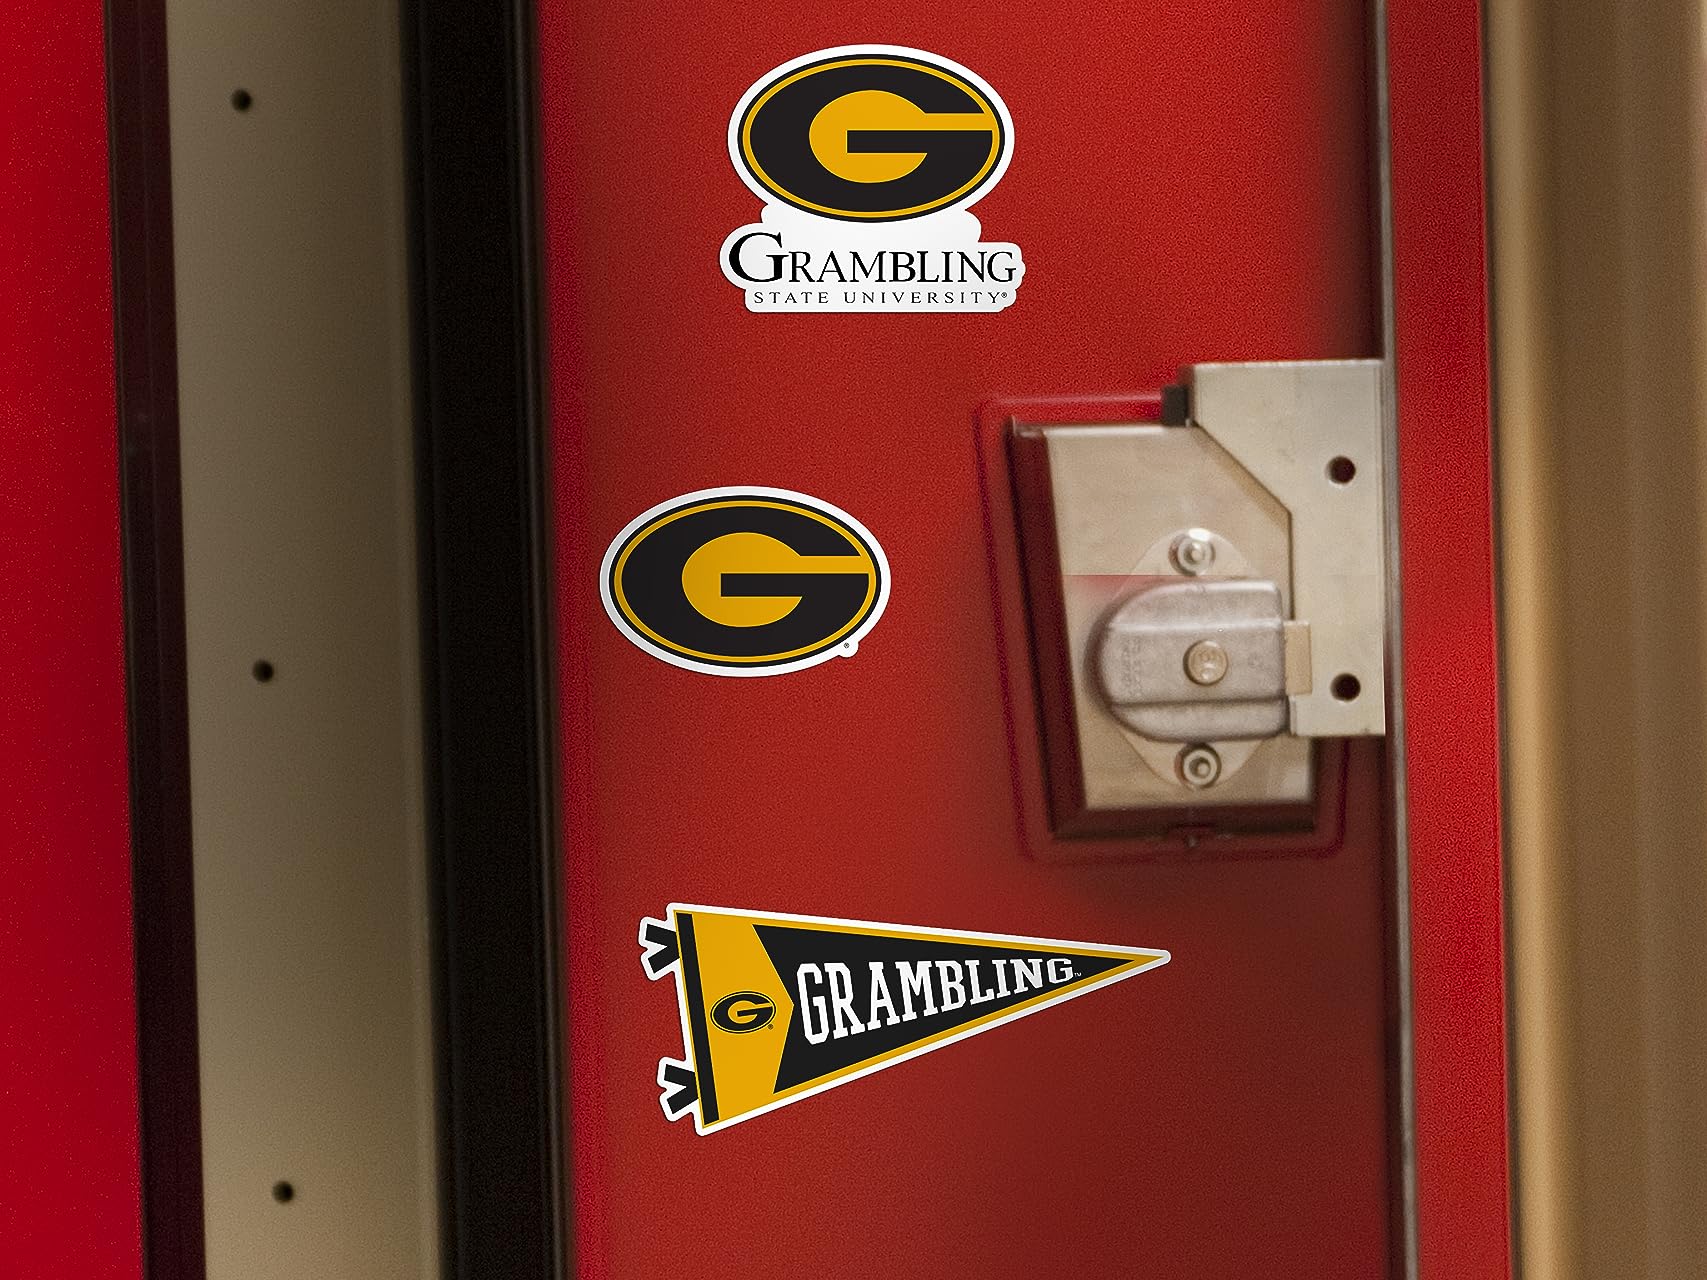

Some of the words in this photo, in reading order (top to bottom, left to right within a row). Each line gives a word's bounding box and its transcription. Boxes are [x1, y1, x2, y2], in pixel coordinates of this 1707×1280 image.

[750, 65, 993, 212] G
[728, 231, 1017, 283] GRAMBLING
[753, 290, 830, 305] STATE
[621, 506, 870, 658] G
[712, 993, 774, 1032] G
[796, 957, 1074, 1046] GRAMBLING
